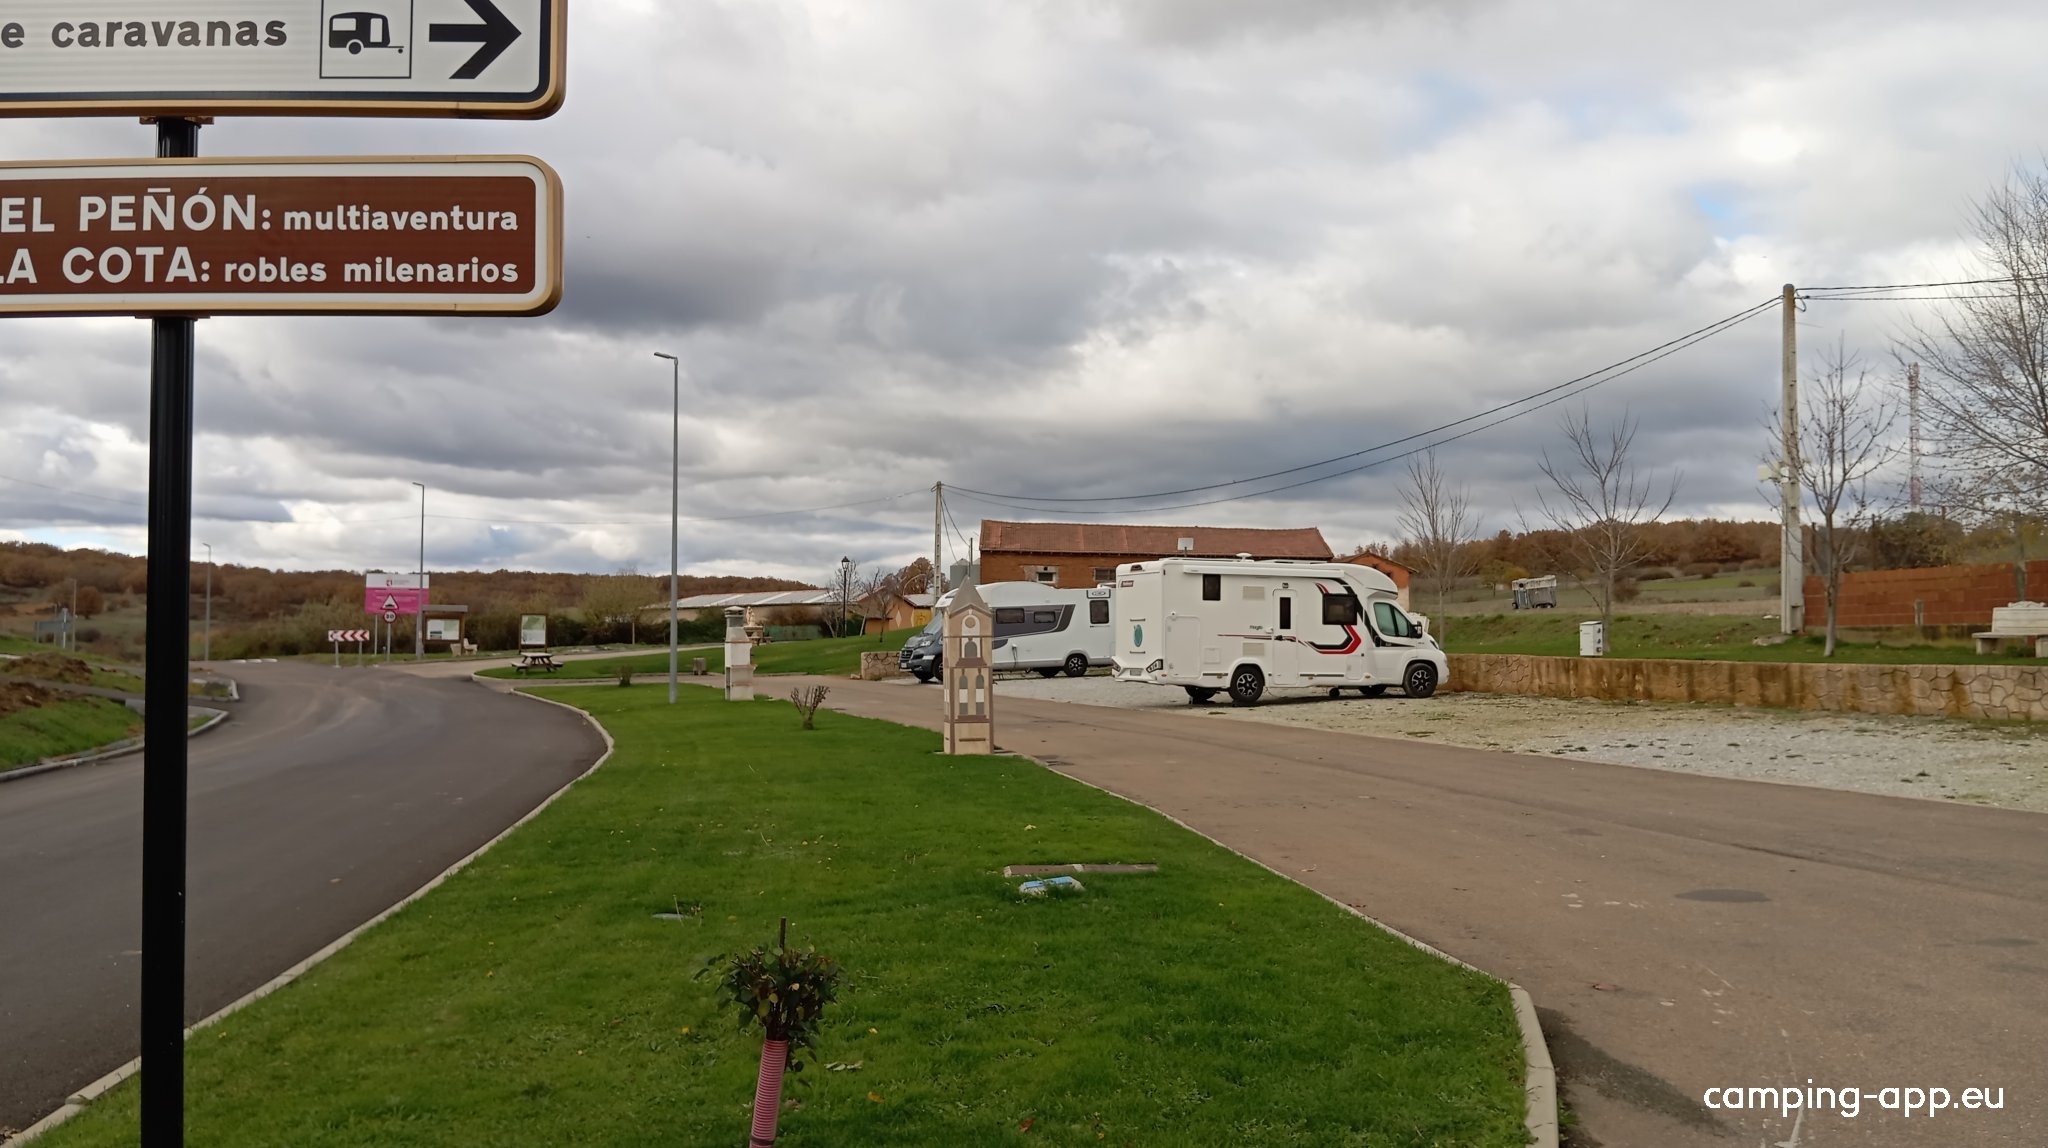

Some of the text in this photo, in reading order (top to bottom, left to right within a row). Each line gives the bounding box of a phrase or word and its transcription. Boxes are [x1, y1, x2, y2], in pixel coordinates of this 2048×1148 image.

[51, 19, 288, 49] caravanas
[0, 187, 518, 233] EL PEÑÓN: multiaventura
[0, 246, 518, 284] A COTA: robles milenarios
